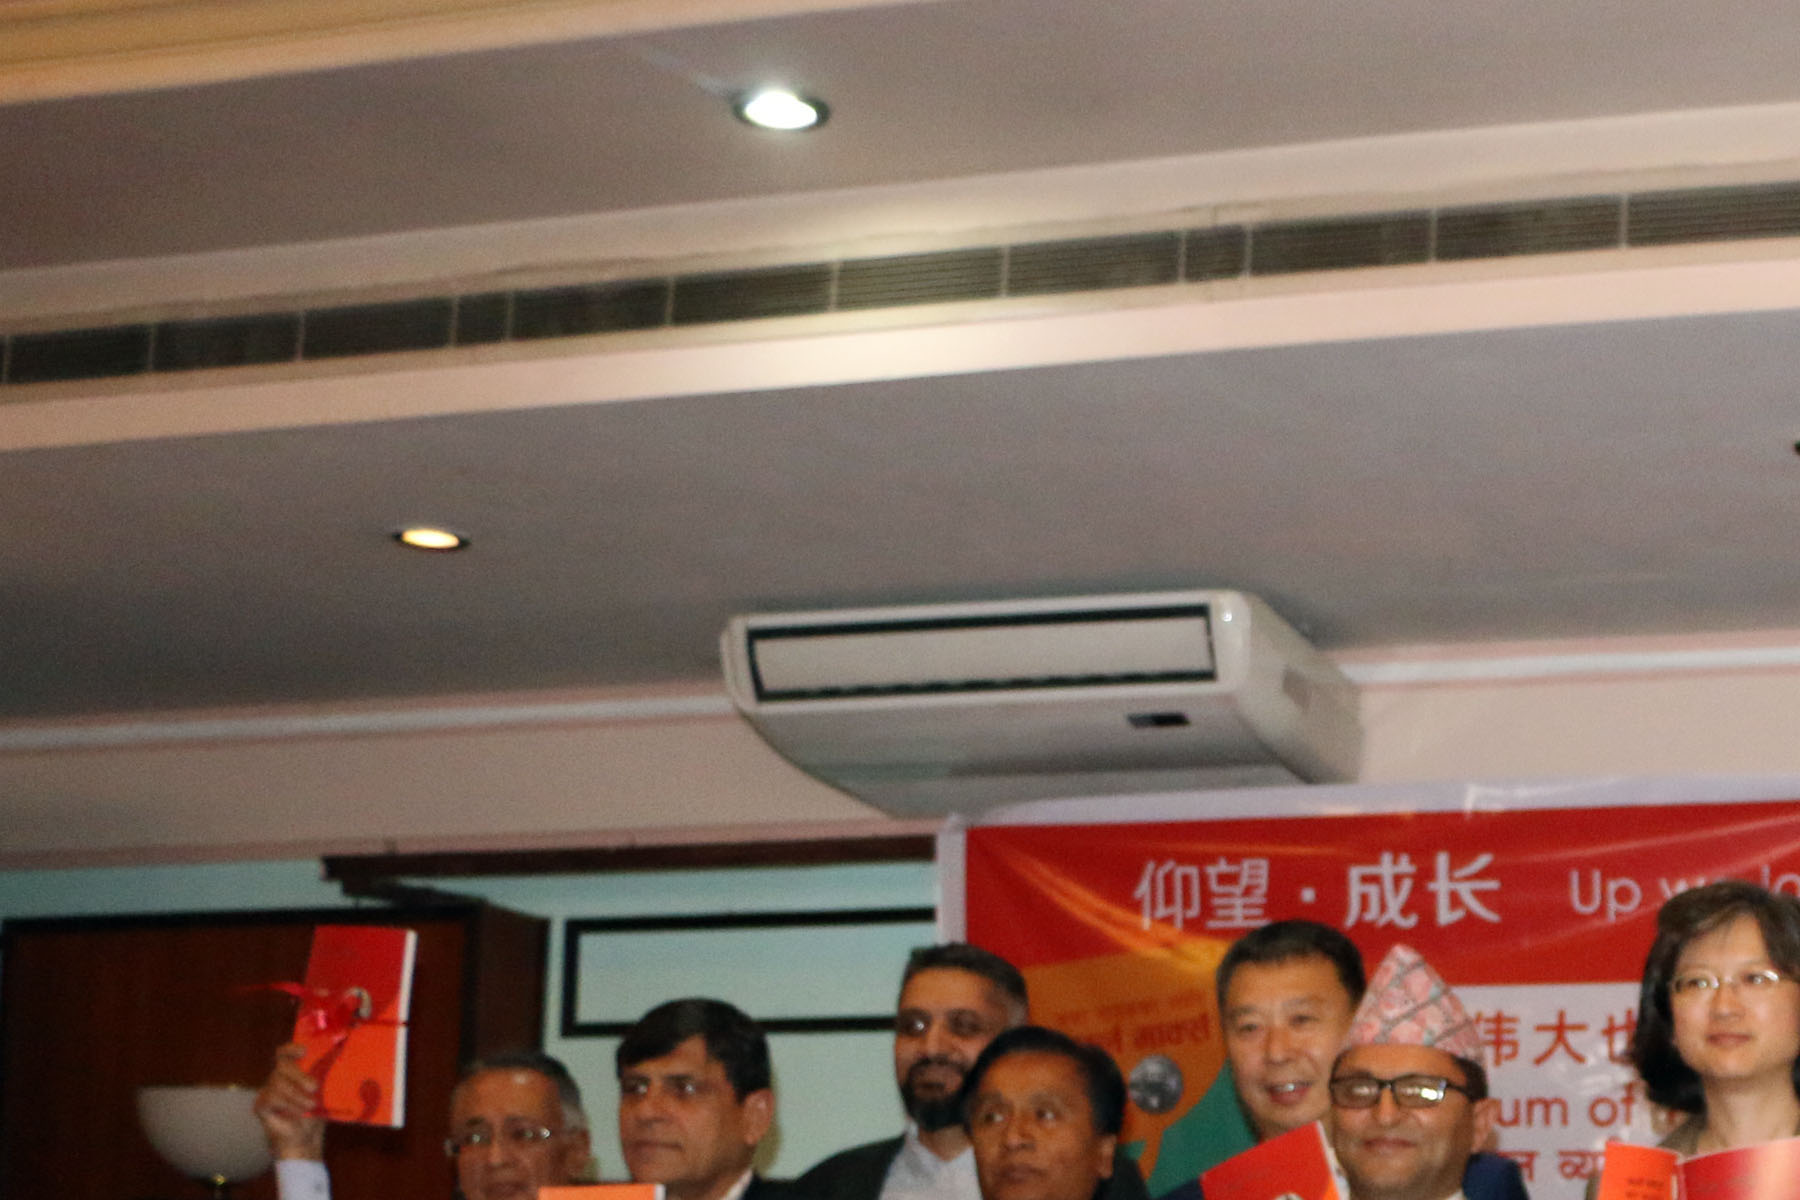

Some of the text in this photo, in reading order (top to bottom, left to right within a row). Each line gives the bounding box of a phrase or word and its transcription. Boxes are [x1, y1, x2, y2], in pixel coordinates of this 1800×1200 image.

[1569, 868, 1643, 922] Up
[1497, 1097, 1569, 1127] um
[1588, 1081, 1636, 1127] of
